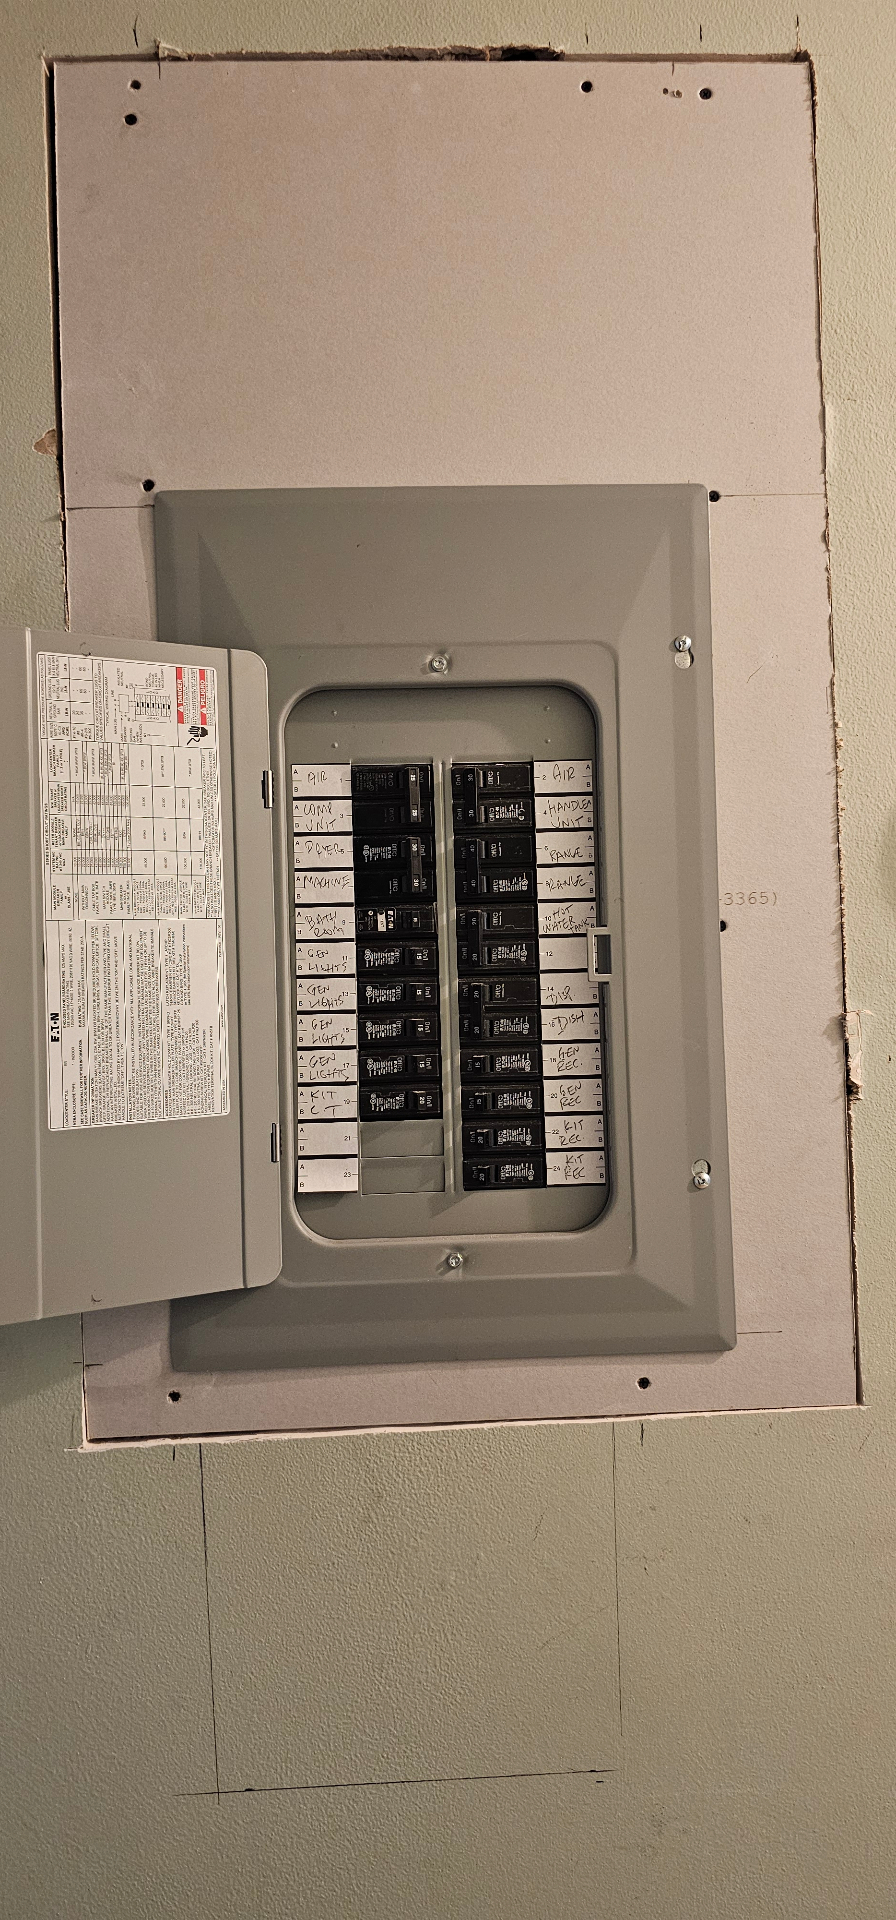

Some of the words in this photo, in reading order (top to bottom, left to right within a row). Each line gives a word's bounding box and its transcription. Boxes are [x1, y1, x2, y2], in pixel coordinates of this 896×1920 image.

[308, 770, 328, 785] AIR
[553, 764, 575, 782] AIR
[306, 817, 336, 832] UNIT
[551, 816, 584, 828] UNIT
[414, 878, 419, 886] 30
[307, 984, 330, 996] GEN
[311, 1018, 332, 1030] GEN
[559, 1046, 580, 1059] GEN
[309, 1053, 336, 1068] GEN
[559, 1081, 582, 1096] GEN
[310, 1090, 337, 1103] KIT
[563, 1119, 584, 1133] KIT
[566, 1154, 584, 1164] KIT
[479, 1173, 485, 1181] 20
